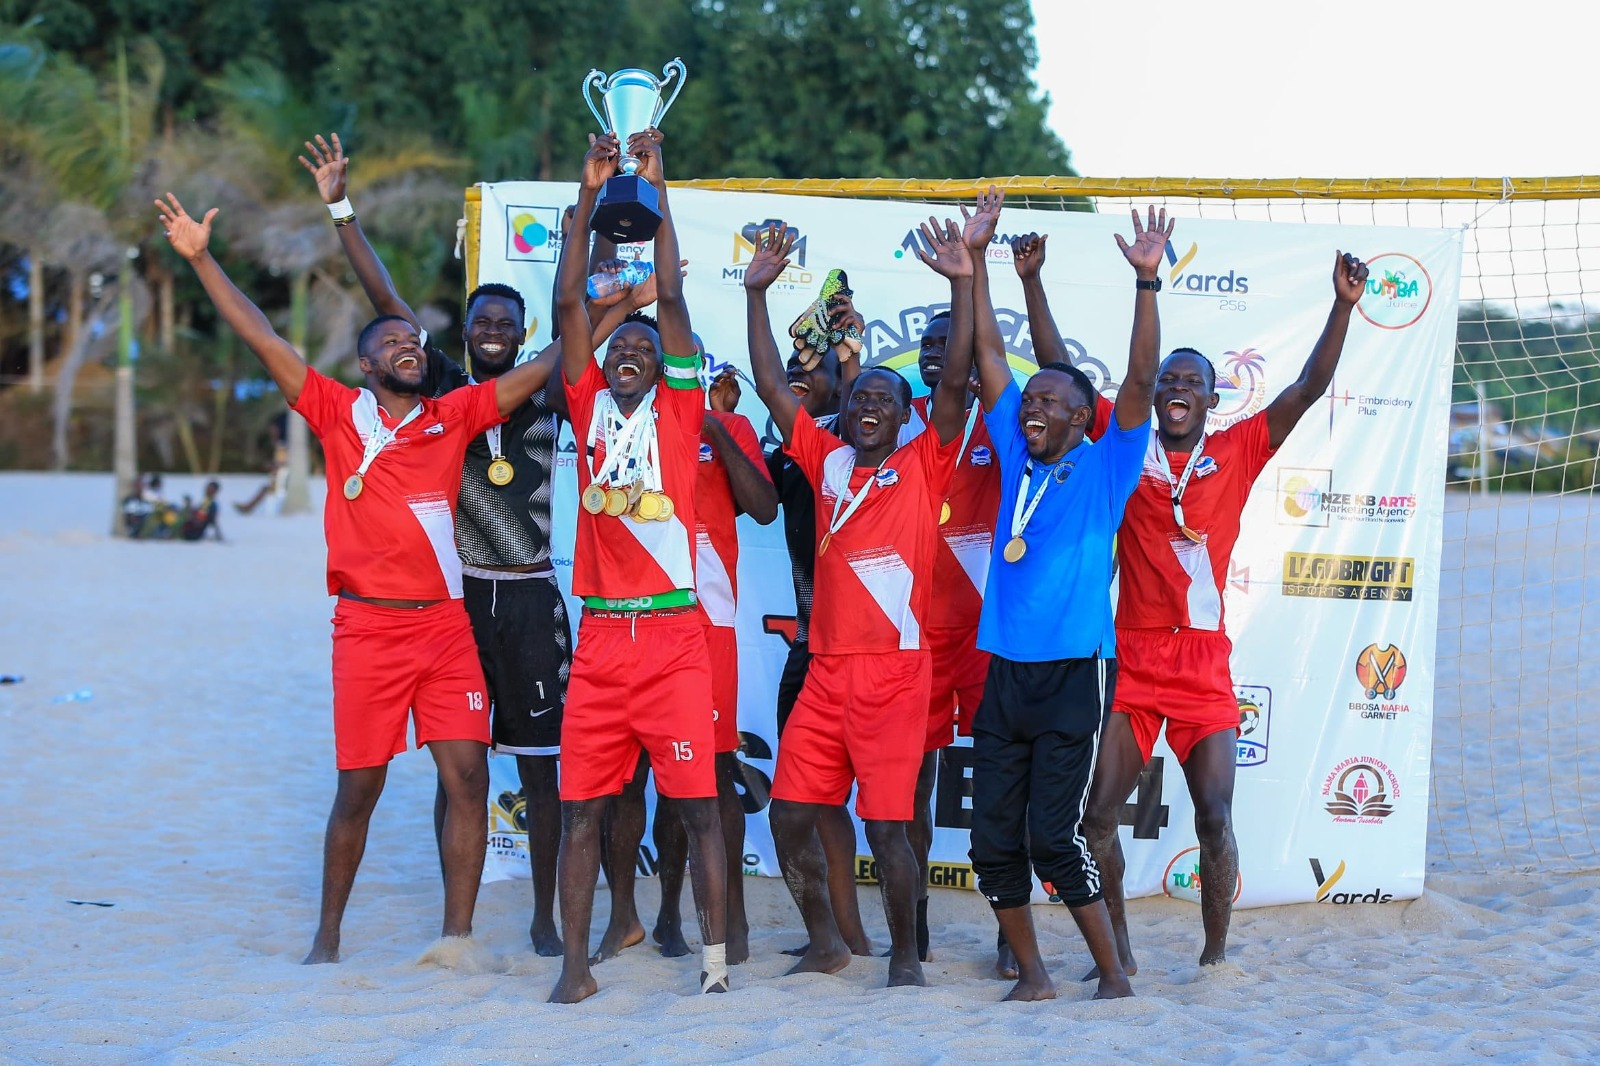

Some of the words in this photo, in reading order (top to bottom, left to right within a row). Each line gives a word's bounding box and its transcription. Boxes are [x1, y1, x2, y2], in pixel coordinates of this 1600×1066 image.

[1219, 299, 1247, 311] 256
[1358, 395, 1413, 408] Embroidery
[1358, 406, 1377, 416] Plus
[1322, 492, 1351, 505] NZE
[1355, 494, 1376, 507] KB
[1378, 496, 1416, 508] ARTS
[1320, 504, 1375, 517] Marketing
[1376, 507, 1415, 518] Agency
[1288, 556, 1411, 584] LEGOBRIGHT
[1287, 586, 1346, 598] SPORTS
[1349, 588, 1409, 600] AGENCY
[535, 681, 545, 700] 1
[466, 691, 484, 711] 18
[1349, 703, 1380, 712] BBOSA
[1381, 703, 1410, 713] MARIA
[1360, 711, 1398, 721] GARMET
[671, 740, 694, 761] 15
[1334, 756, 1359, 774] MARIA
[1360, 755, 1388, 772] JUNIOR
[1385, 769, 1400, 799] SCHOOL
[1172, 872, 1201, 889] TUM
